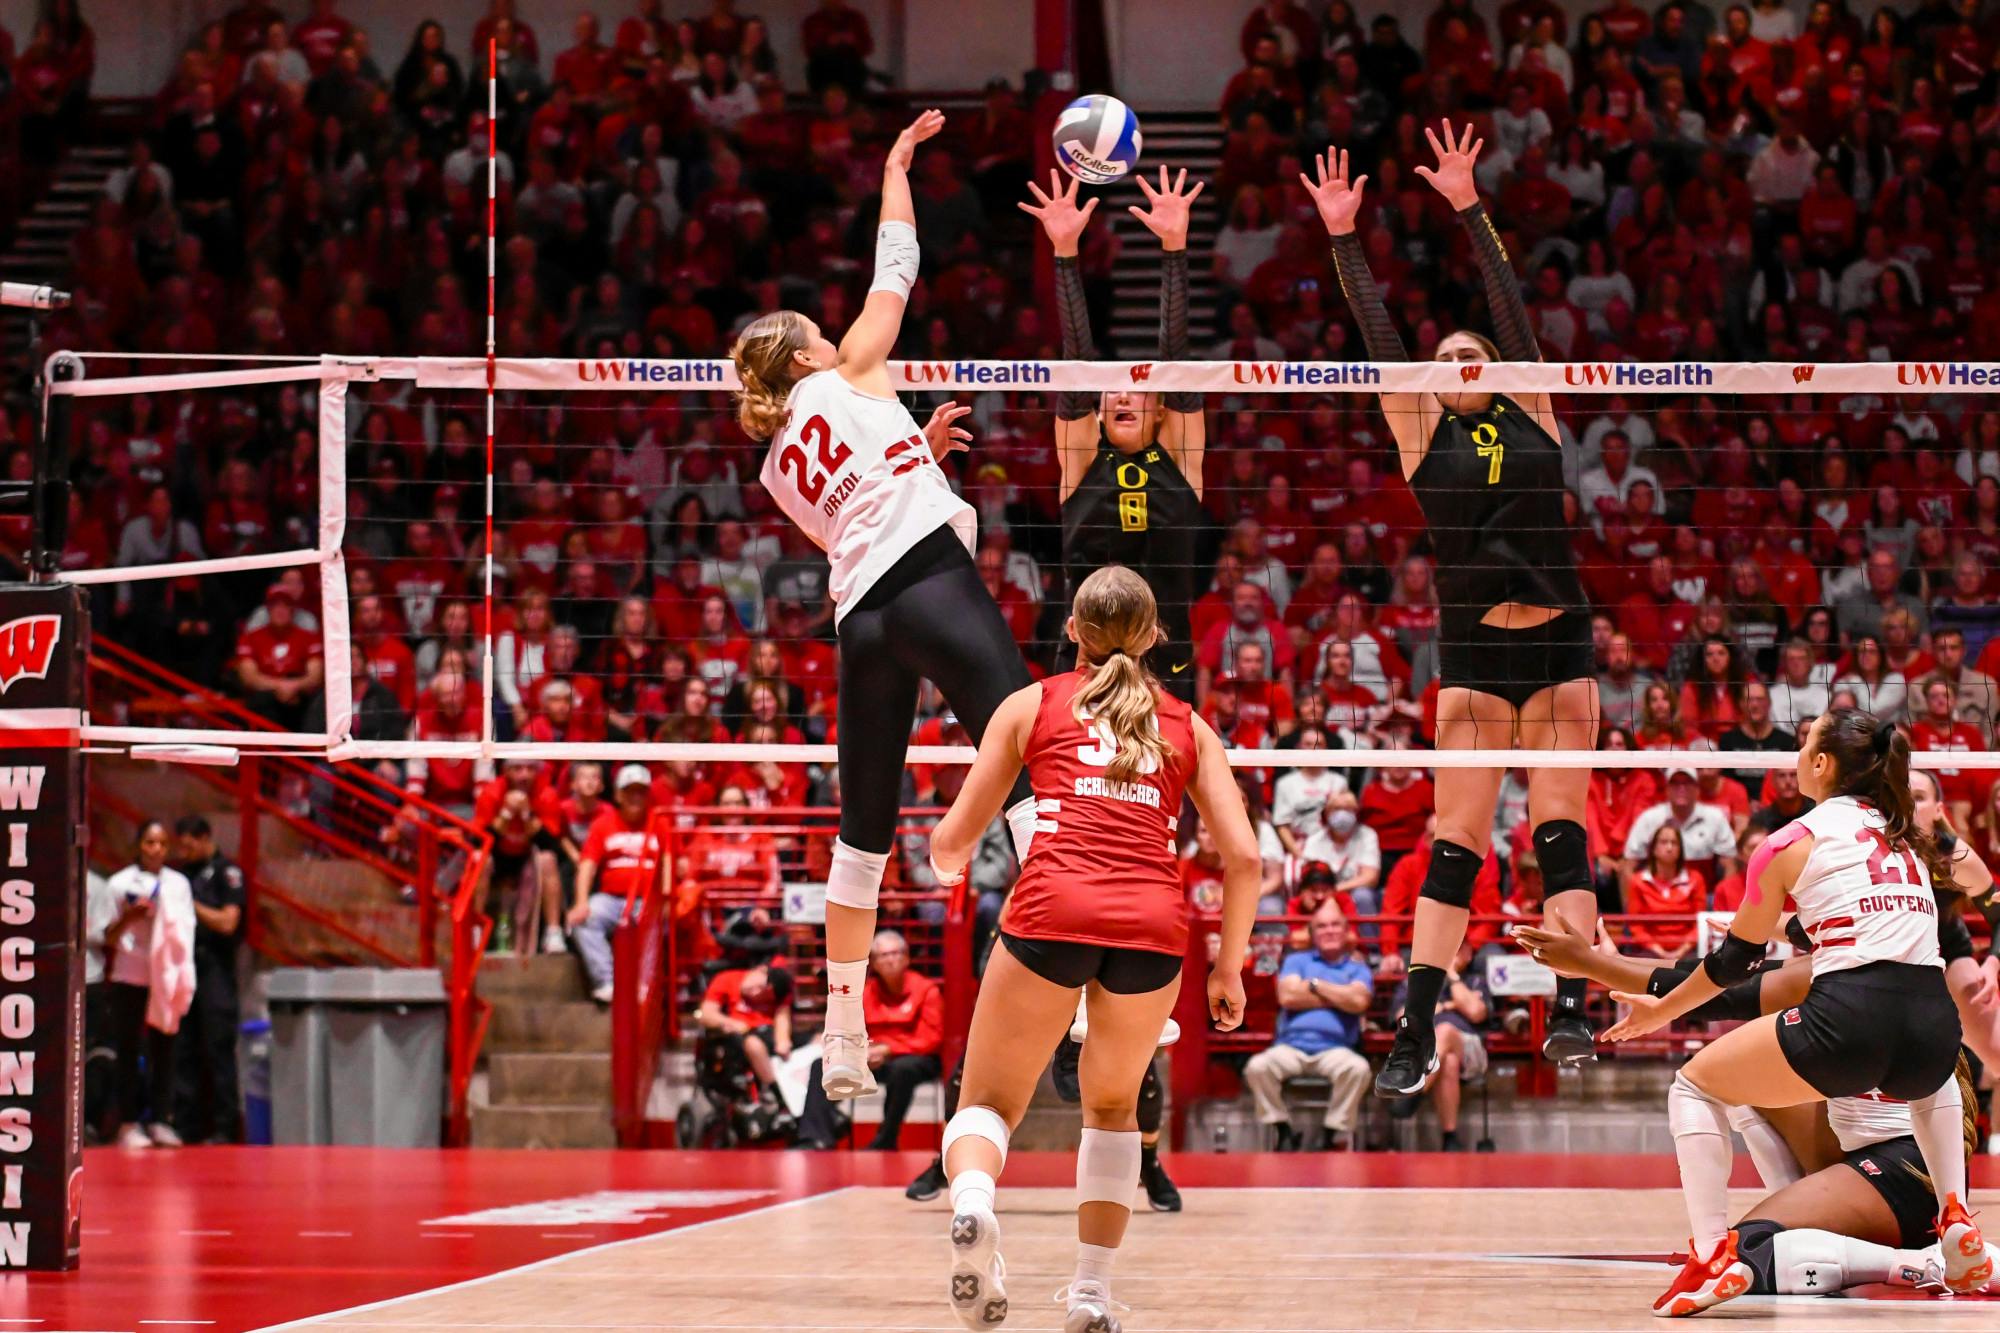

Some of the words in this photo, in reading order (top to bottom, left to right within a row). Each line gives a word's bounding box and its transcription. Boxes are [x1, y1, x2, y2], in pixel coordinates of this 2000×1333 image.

[1072, 149, 1117, 173] molten
[779, 414, 854, 507] 22
[1117, 462, 1148, 489] O
[1477, 443, 1504, 485] 7
[1119, 491, 1148, 532] 8
[1074, 776, 1161, 809] SCHUMACHER
[1855, 828, 1923, 887] 21
